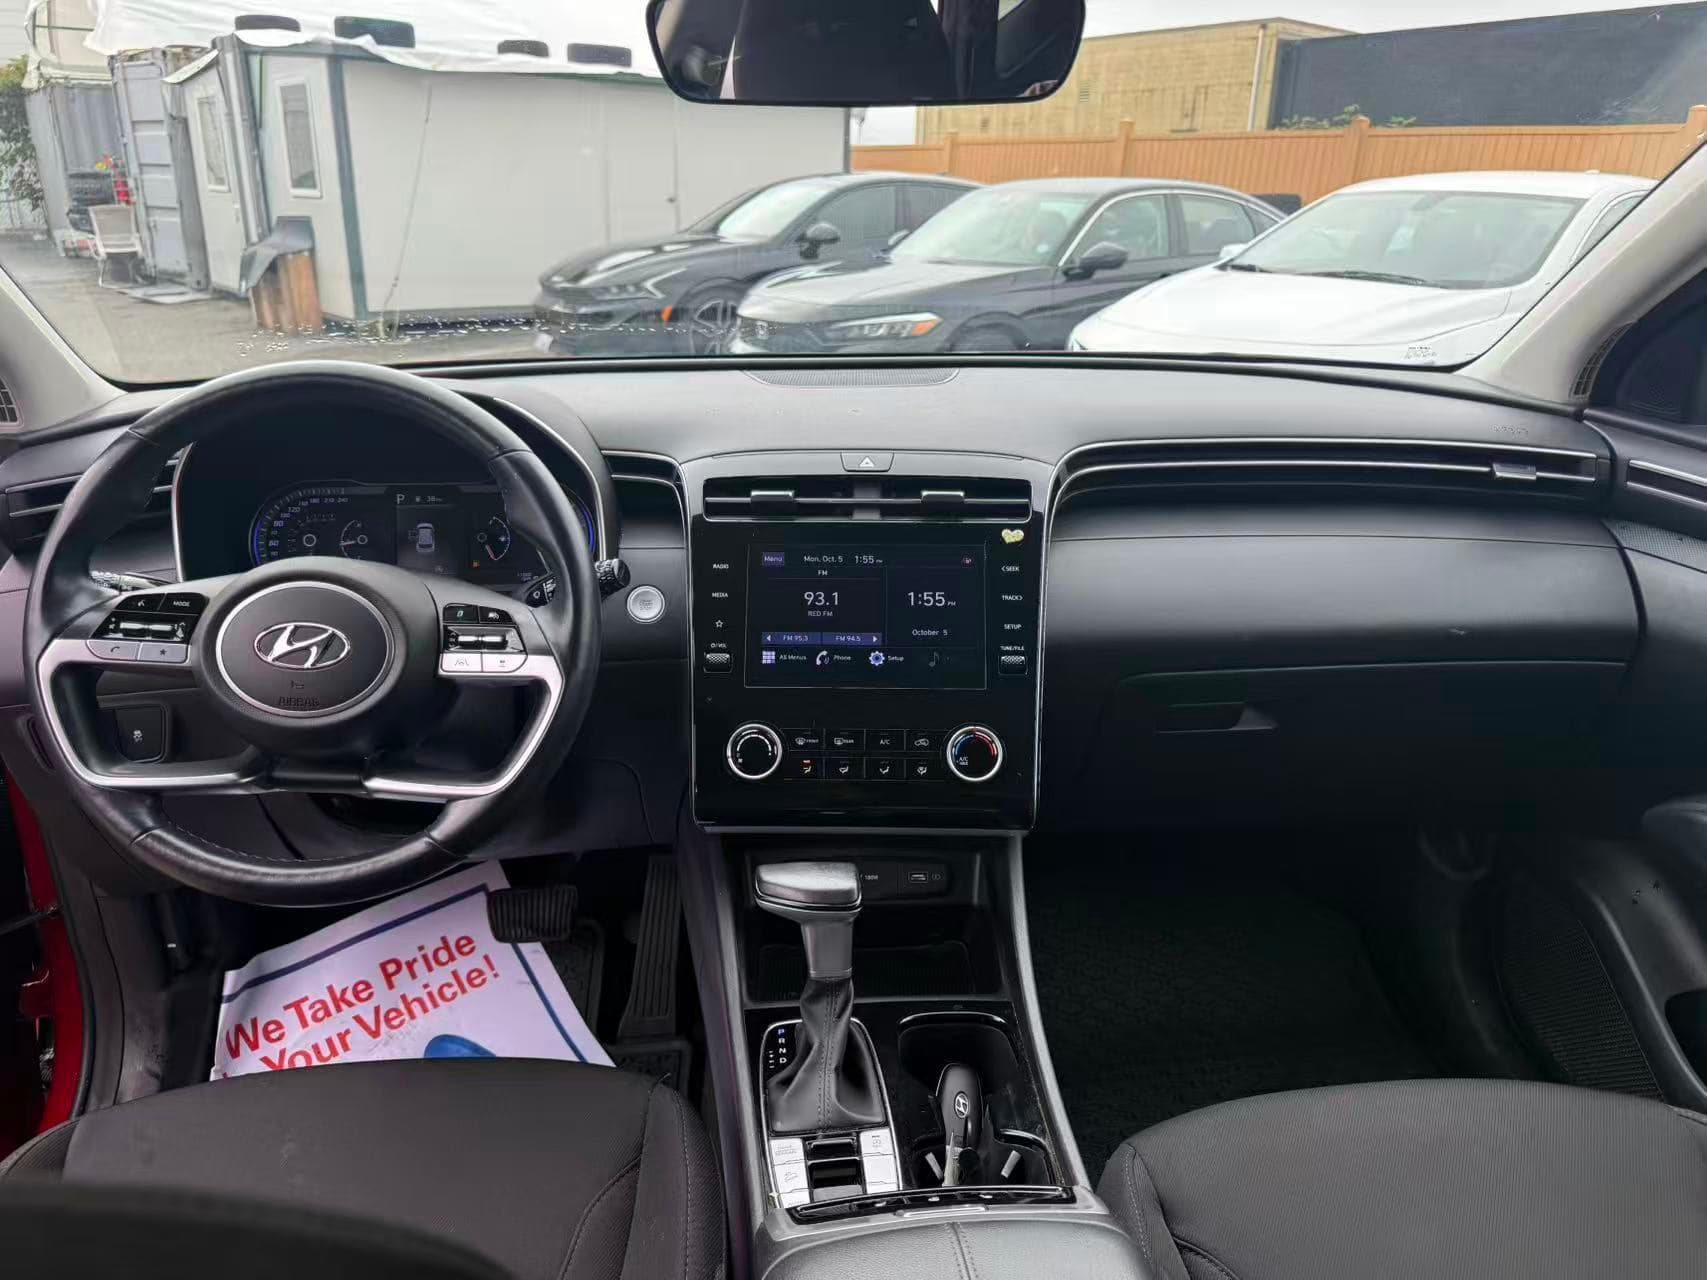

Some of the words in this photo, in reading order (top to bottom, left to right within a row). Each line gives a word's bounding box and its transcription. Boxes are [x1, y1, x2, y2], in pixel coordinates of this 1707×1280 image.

[396, 493, 406, 505] P
[838, 555, 845, 563] 5
[854, 555, 875, 564] 1:55
[803, 591, 839, 606] 93.1
[907, 591, 946, 607] 1:55
[911, 628, 940, 636] October
[225, 1016, 286, 1060] We
[283, 979, 375, 1030] Take
[379, 935, 476, 991] Pride
[259, 1028, 350, 1072] Your
[352, 953, 500, 1040] Vehicle!
